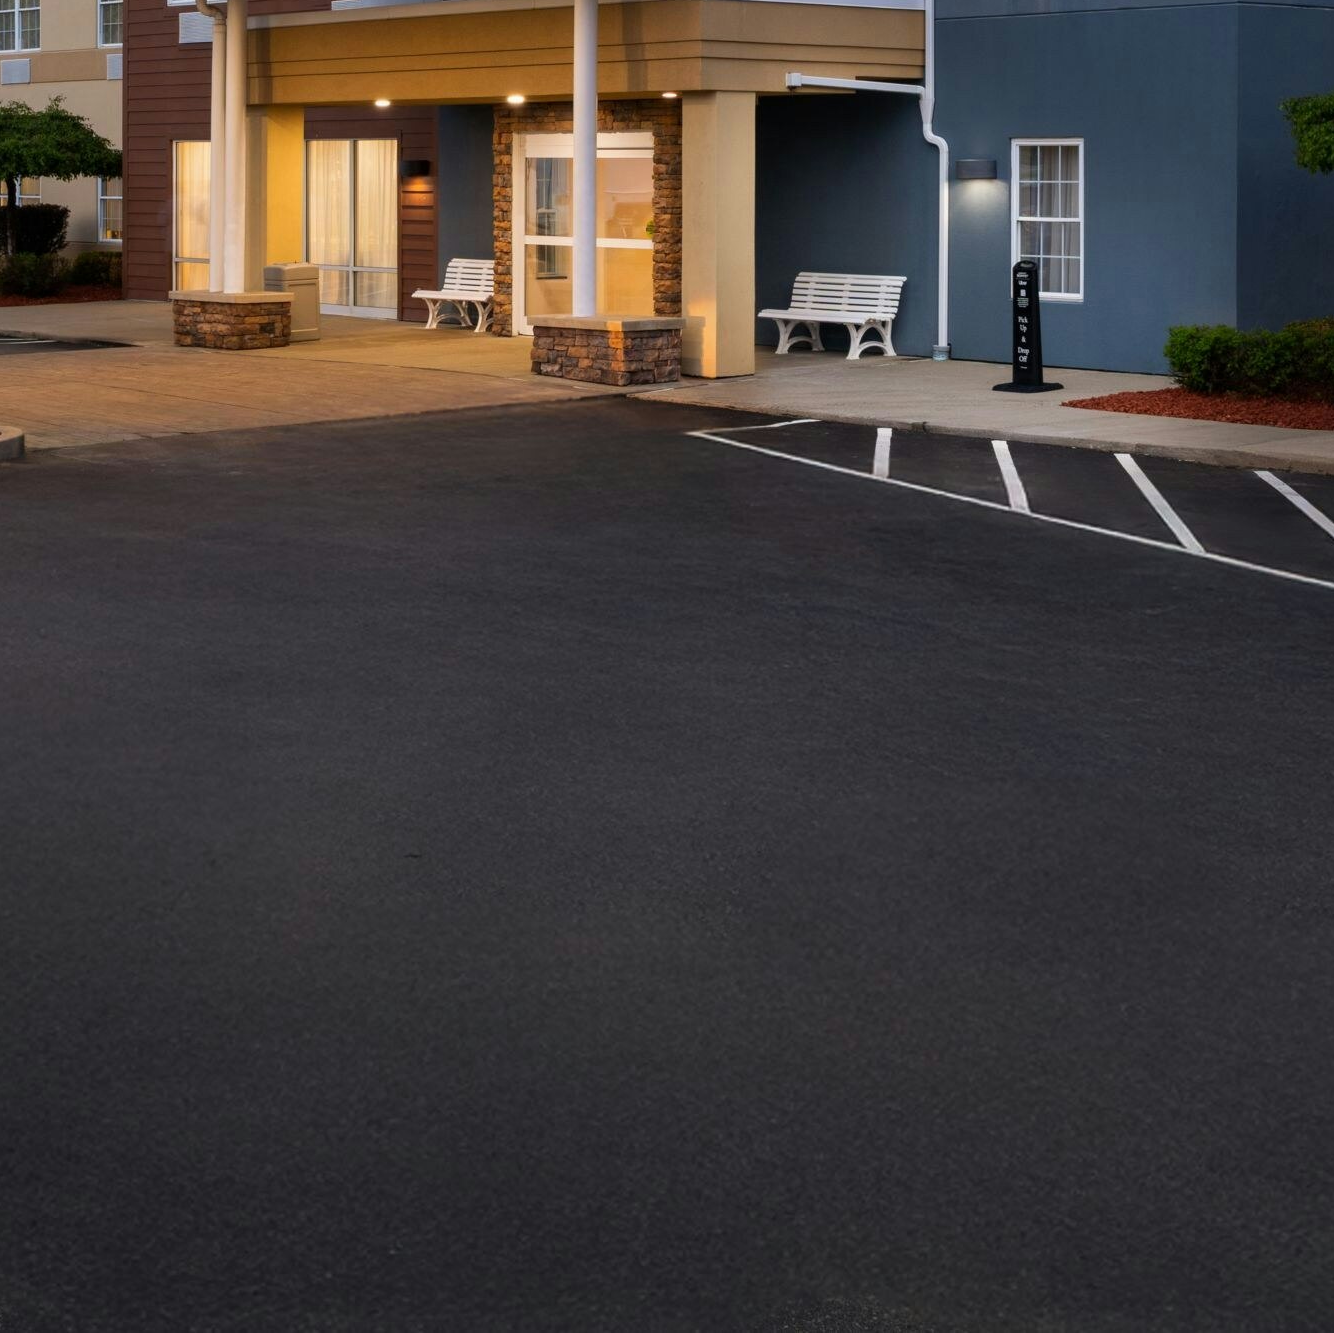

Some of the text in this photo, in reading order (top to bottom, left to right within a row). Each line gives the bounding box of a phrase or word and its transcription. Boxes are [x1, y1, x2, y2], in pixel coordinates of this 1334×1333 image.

[1019, 324, 1027, 333] Up
[1021, 335, 1026, 343] &
[1017, 346, 1030, 356] Drop
[1019, 355, 1027, 363] Off
